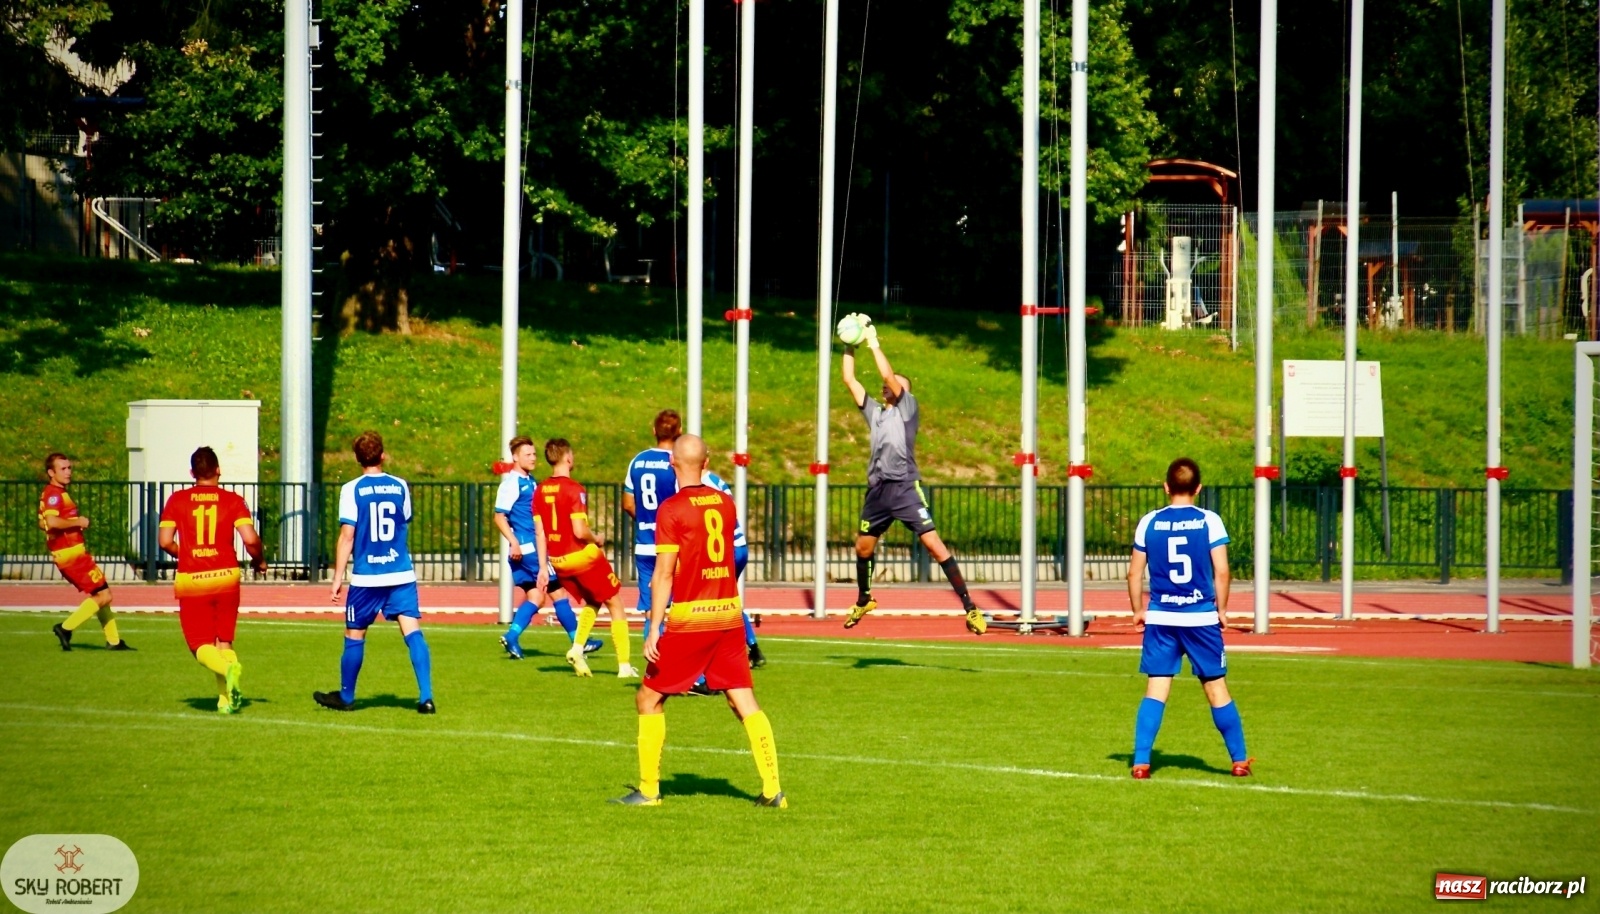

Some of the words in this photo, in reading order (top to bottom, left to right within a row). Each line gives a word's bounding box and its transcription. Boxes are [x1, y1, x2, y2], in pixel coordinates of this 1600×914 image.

[641, 473, 658, 510] 8
[192, 504, 217, 546] 11
[369, 501, 396, 543] 16
[545, 495, 557, 531] 7
[704, 508, 725, 563] 8
[1167, 536, 1192, 584] 5
